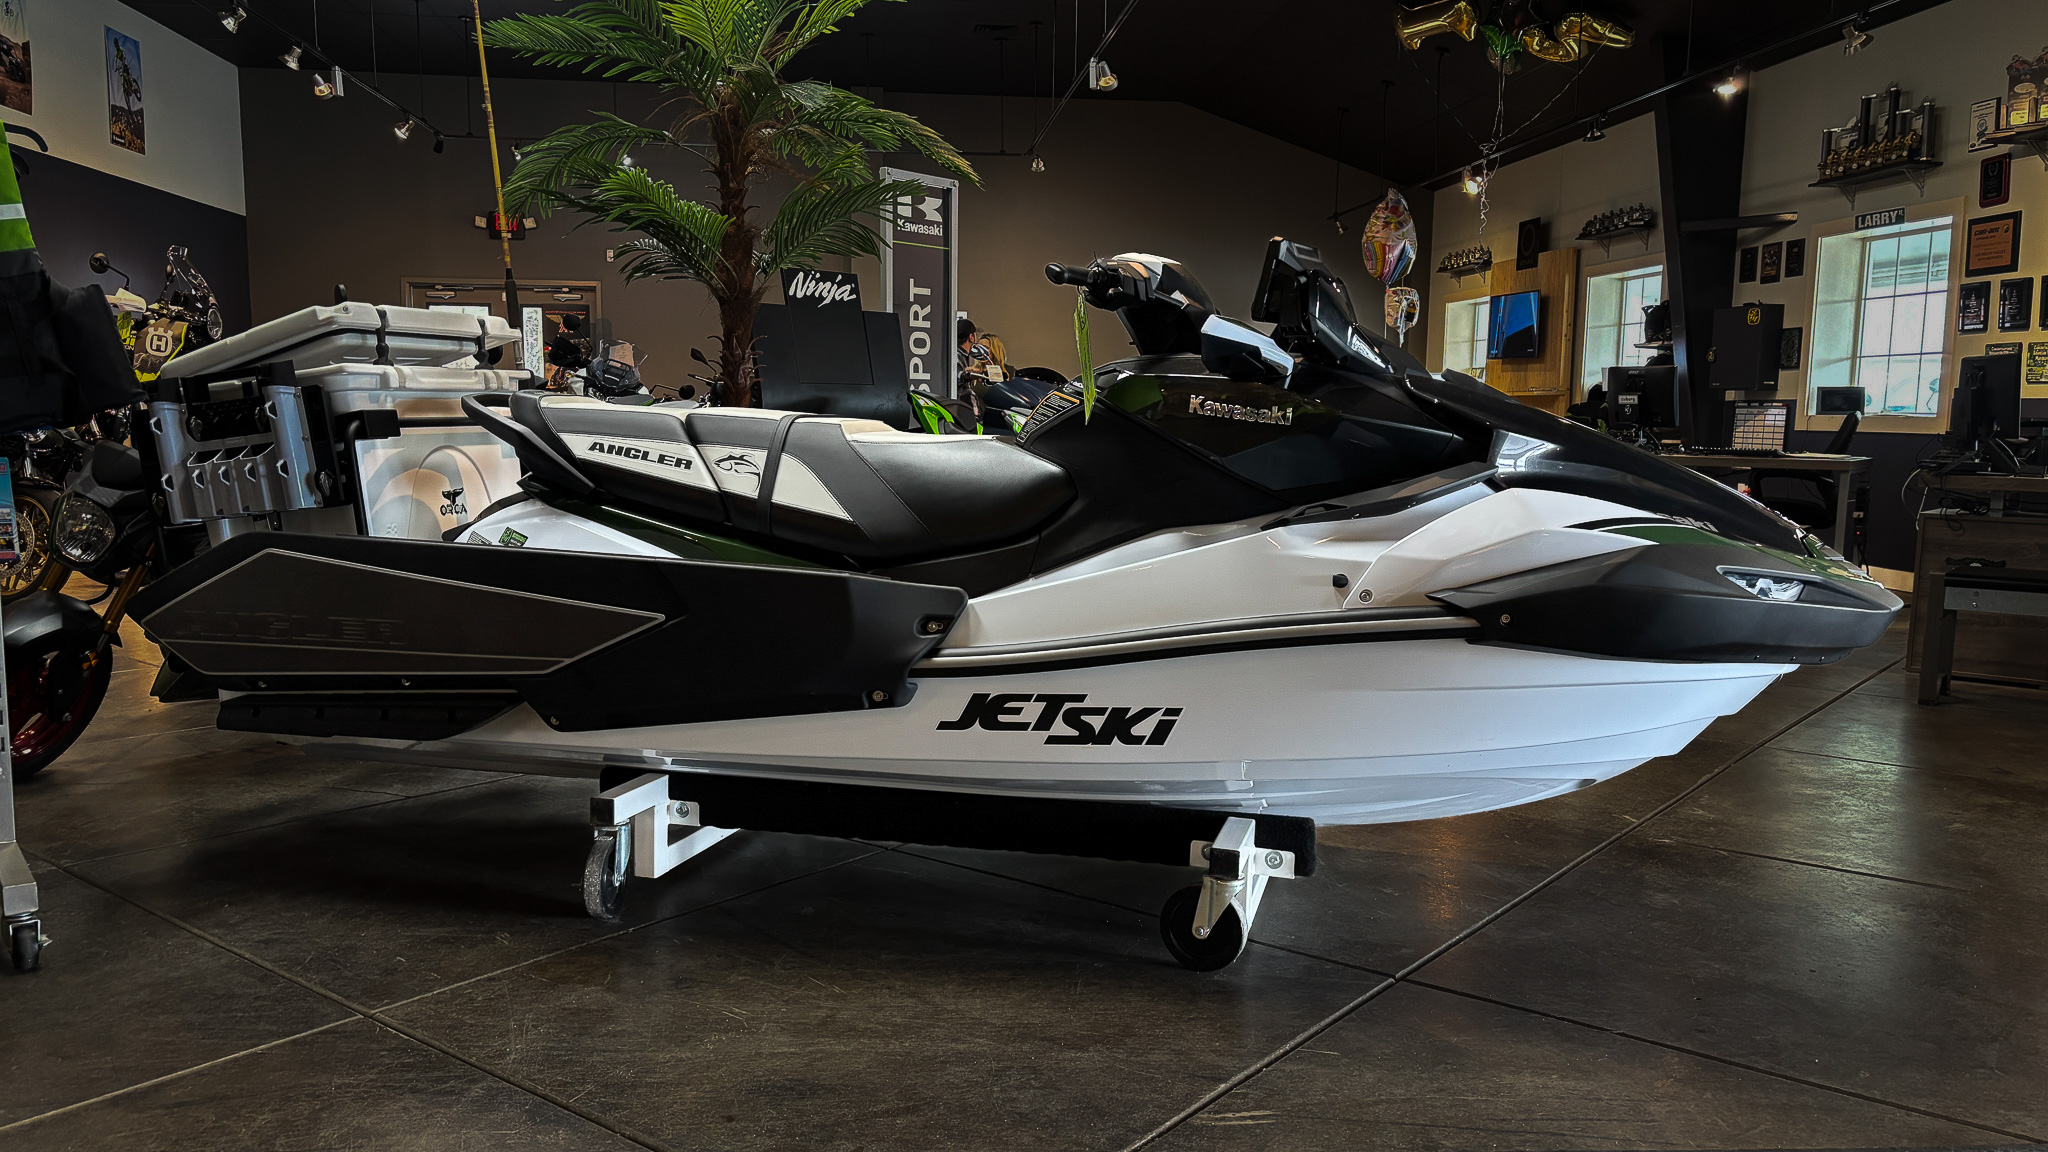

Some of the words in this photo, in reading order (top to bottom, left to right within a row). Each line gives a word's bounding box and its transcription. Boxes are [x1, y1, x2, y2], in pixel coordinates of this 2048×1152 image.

[896, 218, 943, 237] Kawasaki
[1858, 210, 1897, 228] LARRY
[789, 271, 856, 308] Ninja
[1188, 394, 1293, 426] Kawasaki
[588, 441, 693, 470] ANGLER
[440, 503, 467, 516] ORCA
